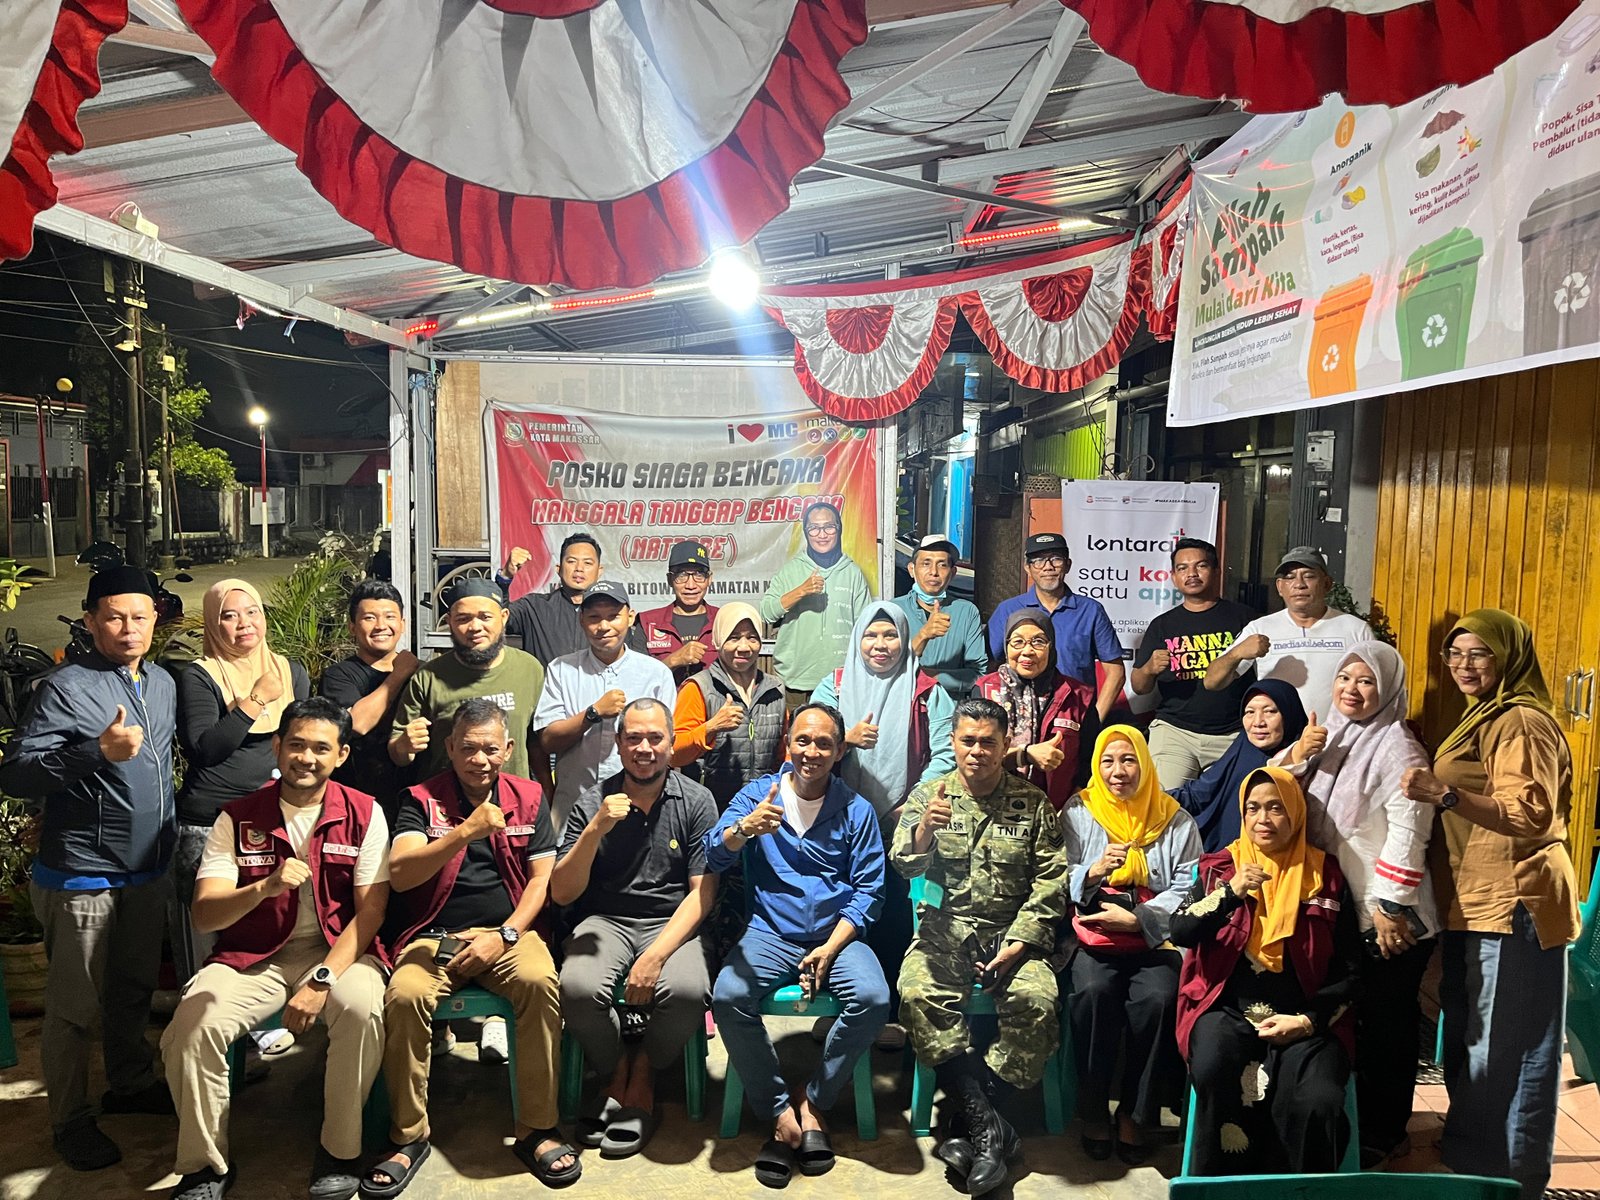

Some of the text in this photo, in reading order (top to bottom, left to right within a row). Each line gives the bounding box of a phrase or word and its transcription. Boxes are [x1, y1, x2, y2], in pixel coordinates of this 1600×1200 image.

[1575, 99, 1594, 115] Sisa
[1532, 111, 1600, 151] Pembalut (tida
[1547, 127, 1600, 159] didaur ulan
[1330, 142, 1374, 176] Anorganik
[1414, 188, 1430, 202] Sisa
[1434, 191, 1449, 205] kulit
[1211, 181, 1271, 254] Pilah
[1417, 205, 1444, 225] dijadikan
[1200, 202, 1285, 295] Sampah
[1194, 271, 1297, 328] Mulai dari Kita
[1253, 312, 1274, 326] LEBIH
[1274, 305, 1299, 320] SEHAT
[1256, 338, 1269, 350] agar
[1269, 330, 1292, 345] mudah
[529, 422, 583, 433] PEMERINTAH
[767, 422, 799, 438] MC
[530, 433, 600, 444] KOTA MAKASSAR
[547, 455, 826, 489] POSKO SIAGA BENCANA
[531, 494, 845, 526] MANGGALA TANGGAP BENCA
[1078, 566, 1129, 582] satu
[628, 582, 675, 596] BITOW
[1078, 584, 1184, 606] satu app
[1118, 618, 1150, 628] aplikas
[1164, 631, 1234, 654] MANNA
[997, 826, 1017, 836] TNI
